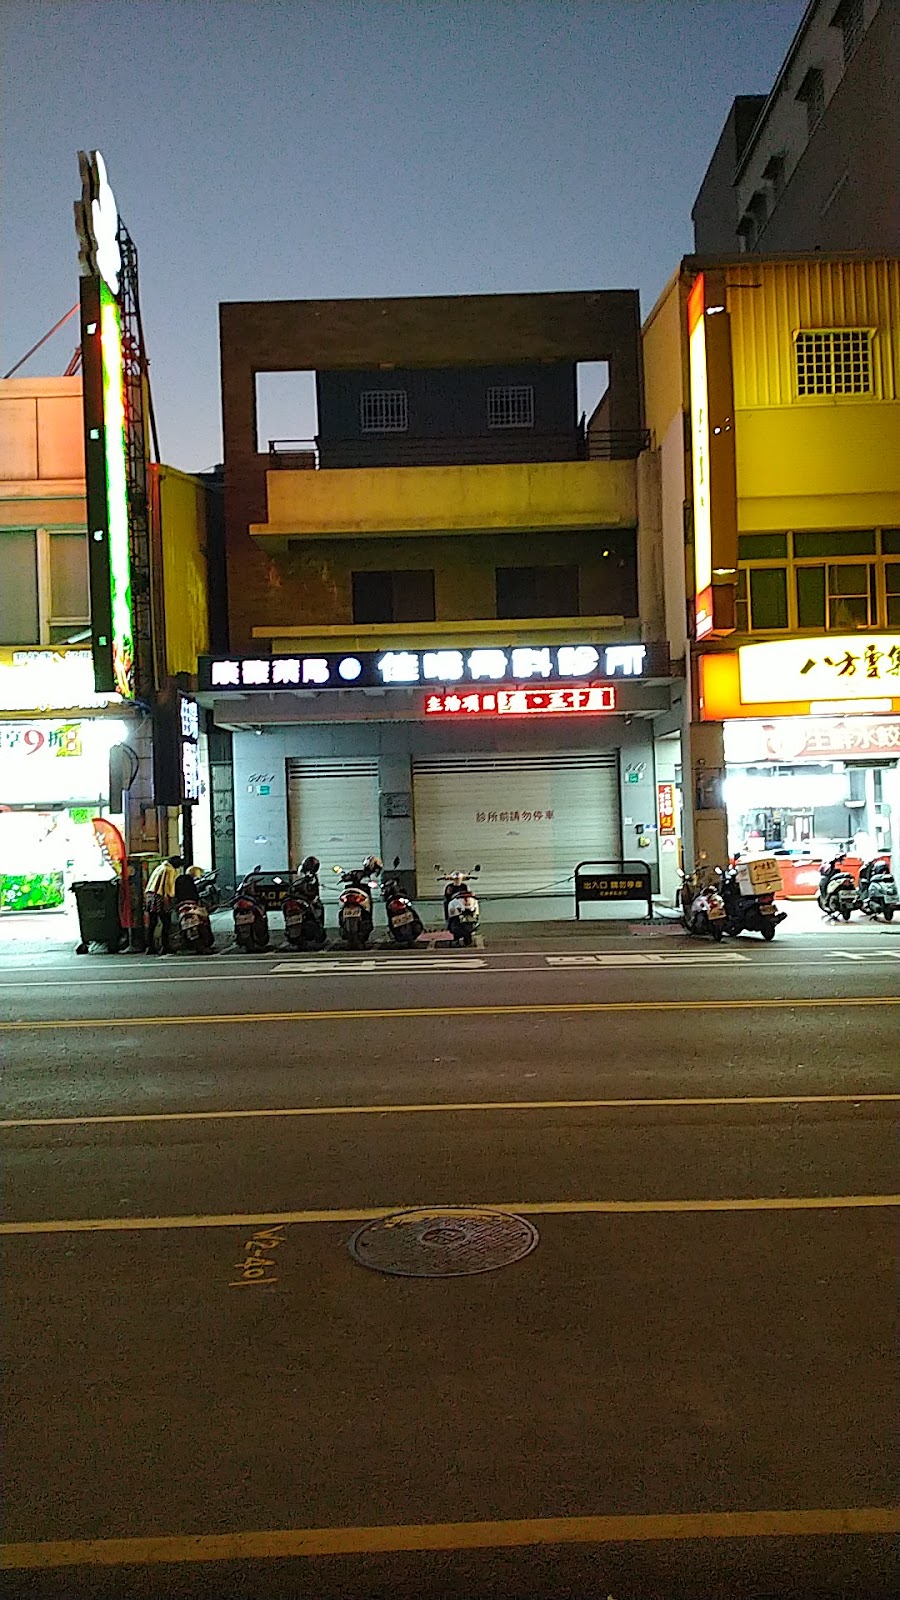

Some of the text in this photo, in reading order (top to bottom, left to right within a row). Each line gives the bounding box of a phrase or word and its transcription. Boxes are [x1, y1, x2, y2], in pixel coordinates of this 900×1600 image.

[476, 809, 555, 823] 診所前請勿停車
[583, 880, 608, 890] 出入口
